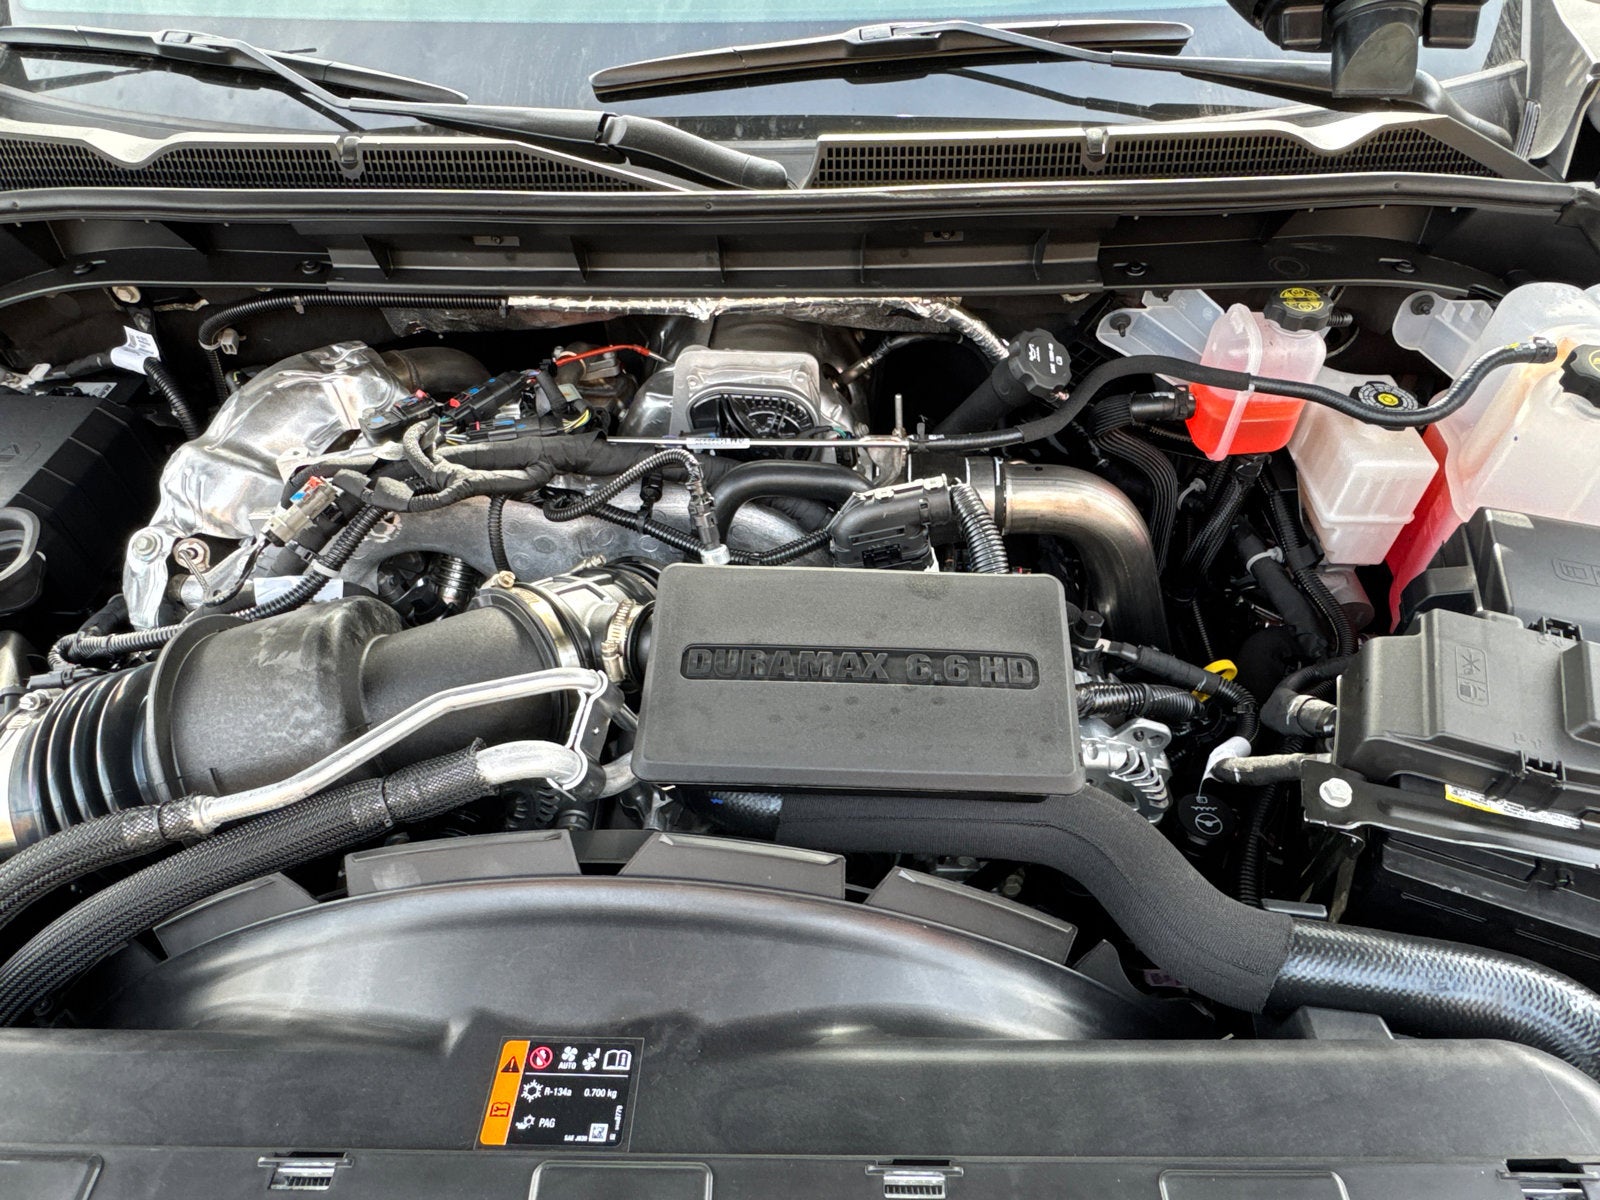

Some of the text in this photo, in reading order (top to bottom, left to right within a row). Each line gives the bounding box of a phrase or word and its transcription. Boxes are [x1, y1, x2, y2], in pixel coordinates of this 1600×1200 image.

[687, 648, 1034, 684] DURAMAX 6.6 HD
[558, 1061, 576, 1069] AUTO
[544, 1087, 617, 1099] R-134a 0.700 kg
[539, 1118, 556, 1128] PAG
